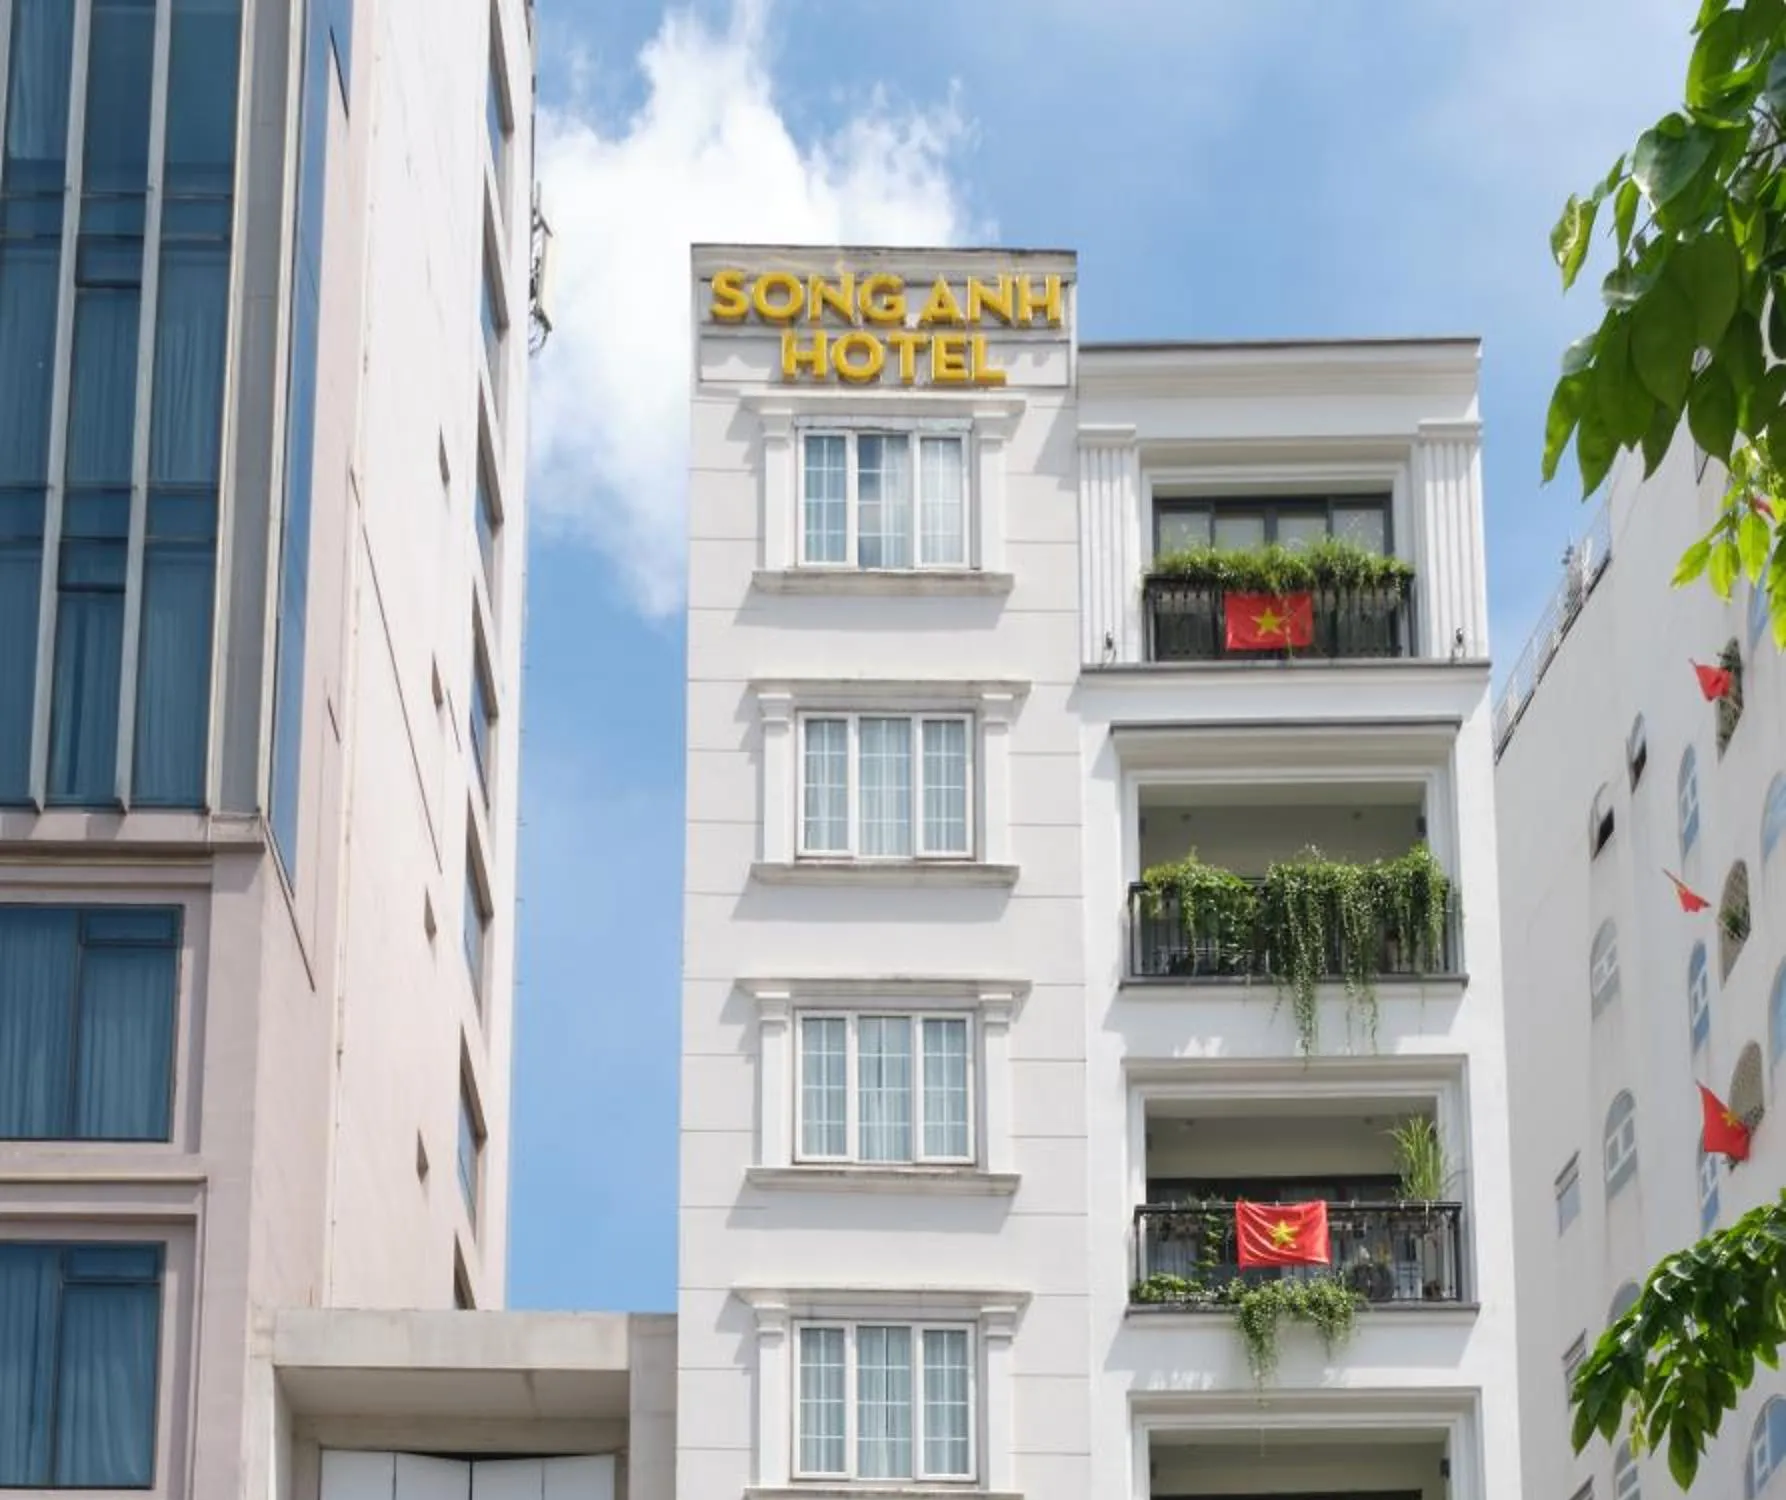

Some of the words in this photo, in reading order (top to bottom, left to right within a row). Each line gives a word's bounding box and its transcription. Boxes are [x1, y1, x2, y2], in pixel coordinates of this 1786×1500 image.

[710, 268, 905, 326] SONG
[917, 273, 1064, 329] ANH
[781, 328, 1007, 386] HOTEL
